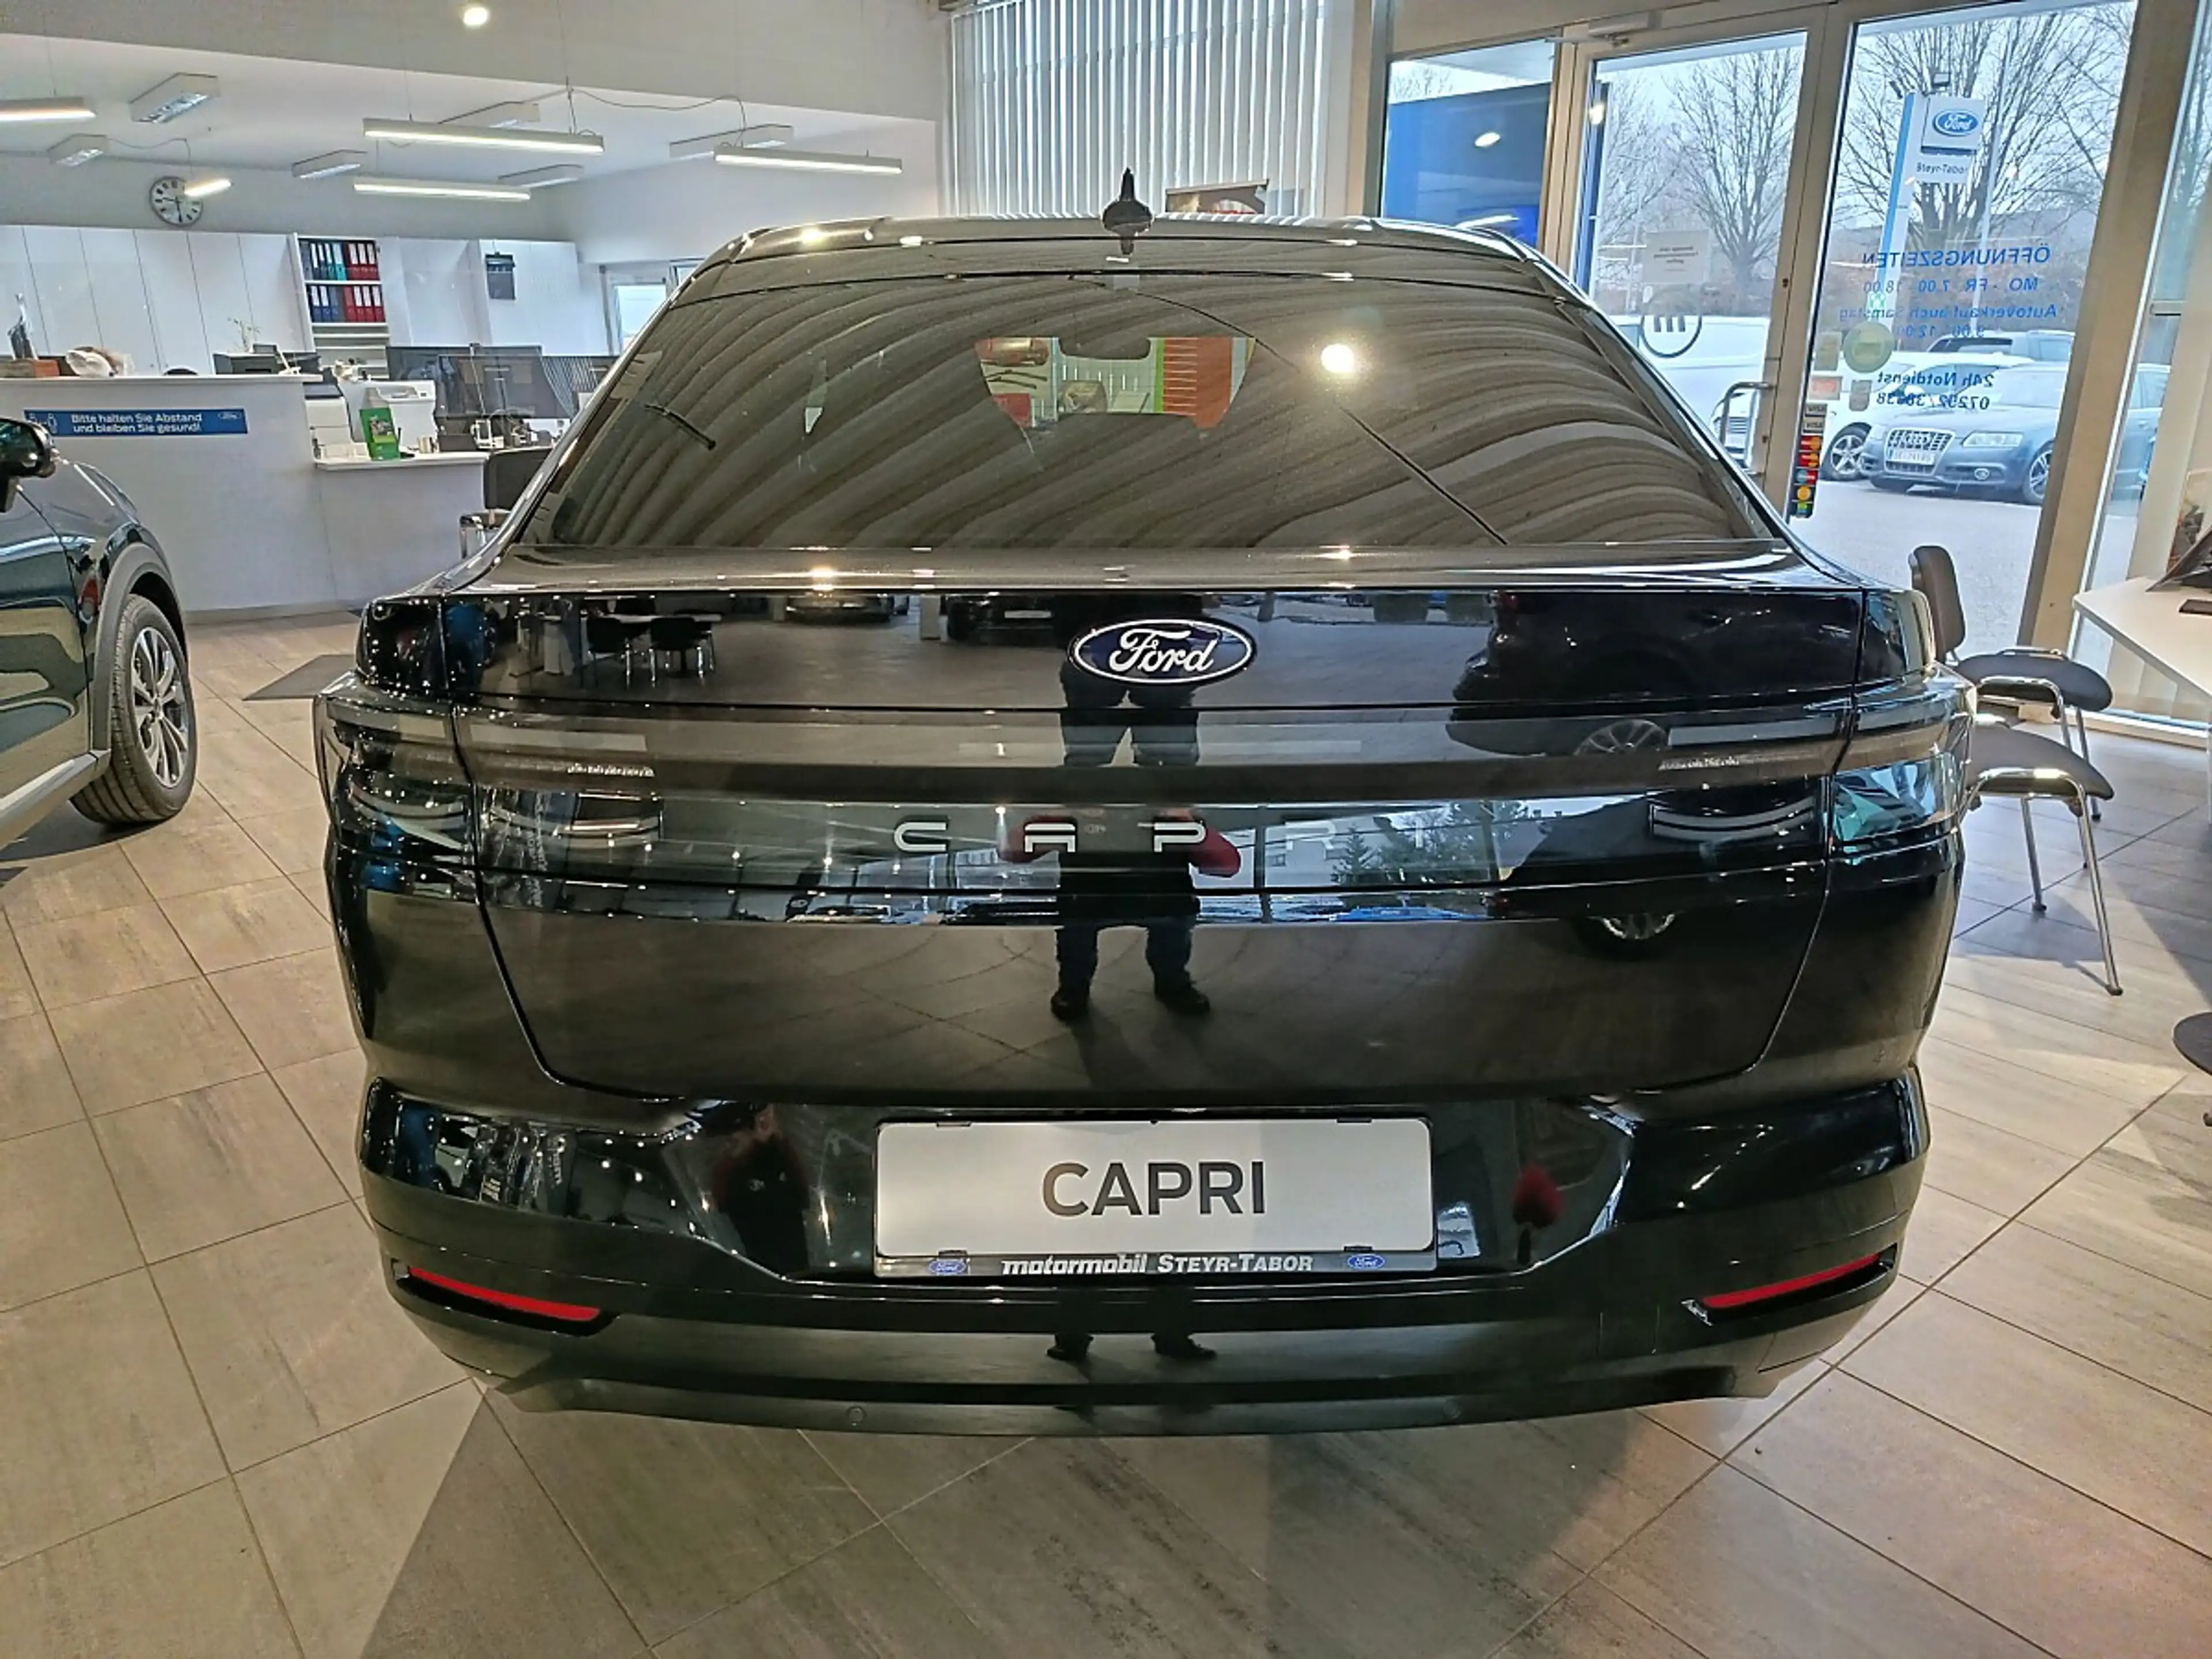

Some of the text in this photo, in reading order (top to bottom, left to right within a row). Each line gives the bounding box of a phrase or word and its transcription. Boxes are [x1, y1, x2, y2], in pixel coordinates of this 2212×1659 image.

[1944, 114, 1973, 130] Ford
[71, 412, 202, 423] Bitte halten Sie Abstand
[73, 423, 201, 434] und bleiben Sie gesund!
[1109, 628, 1218, 672] Ford
[1042, 1160, 1266, 1218] CAPRI
[1001, 1253, 1313, 1275] motormobil STEYR-TABOR
